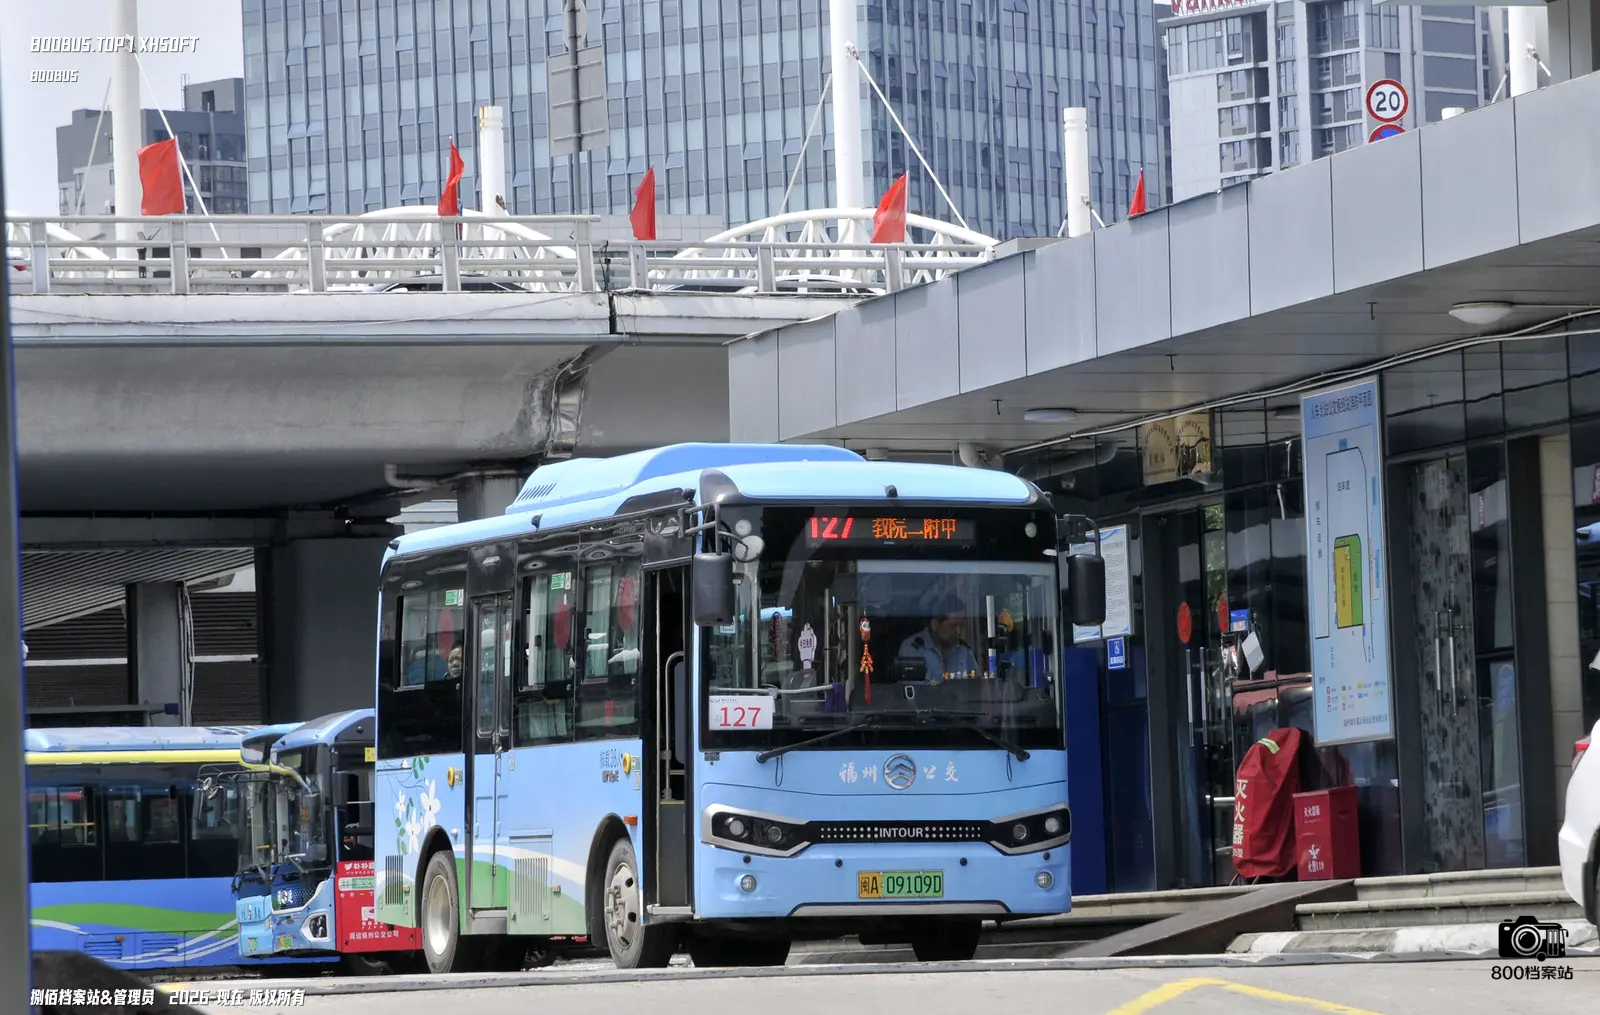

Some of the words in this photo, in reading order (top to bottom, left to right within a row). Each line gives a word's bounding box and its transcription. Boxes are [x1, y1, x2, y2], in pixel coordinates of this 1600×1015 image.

[1375, 91, 1400, 112] 20
[719, 706, 761, 727] 127
[838, 762, 878, 783] 福州
[923, 761, 959, 782] 公交
[1232, 778, 1248, 845] 灭火器
[879, 827, 924, 838] INTOUR
[860, 876, 879, 895] 闽A
[886, 875, 942, 894] 09109D
